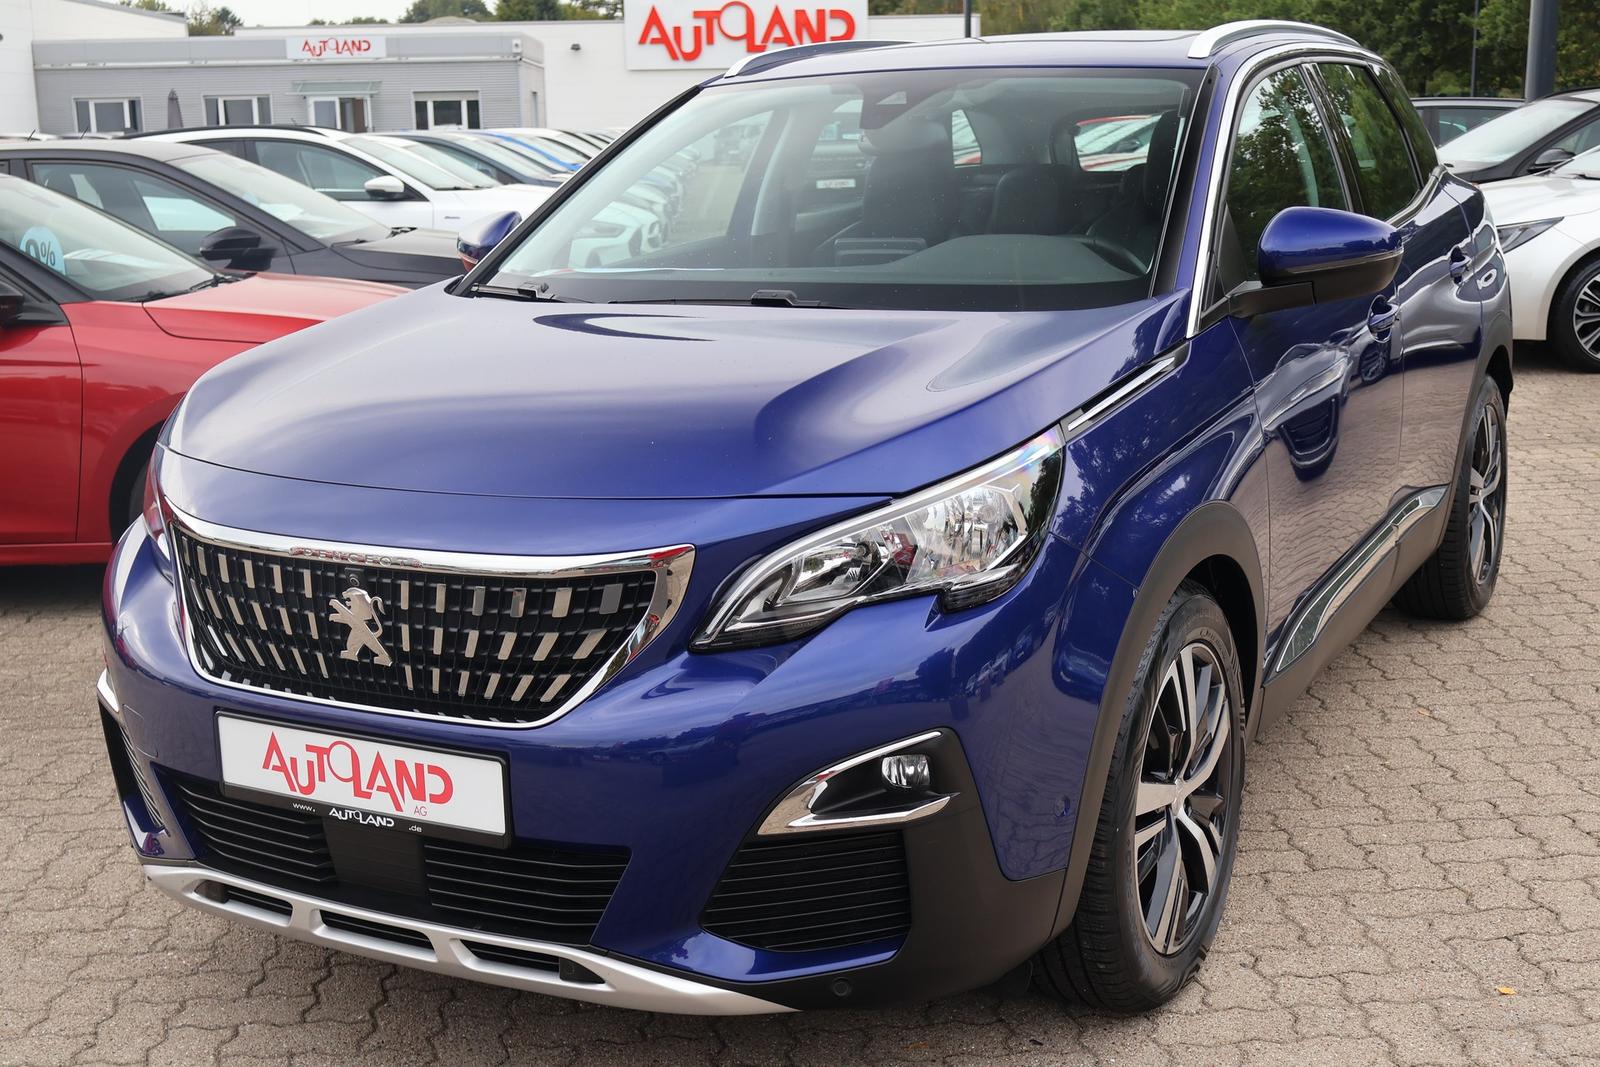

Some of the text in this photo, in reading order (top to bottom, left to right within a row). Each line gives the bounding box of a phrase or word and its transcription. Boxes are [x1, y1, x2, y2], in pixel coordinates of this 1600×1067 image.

[638, 1, 856, 61] AUTOLAND
[302, 37, 371, 56] AUTOLAND
[262, 731, 454, 813] AUTOLAND
[292, 803, 423, 833] www. AUTOLAND .de
[413, 806, 428, 818] AG
